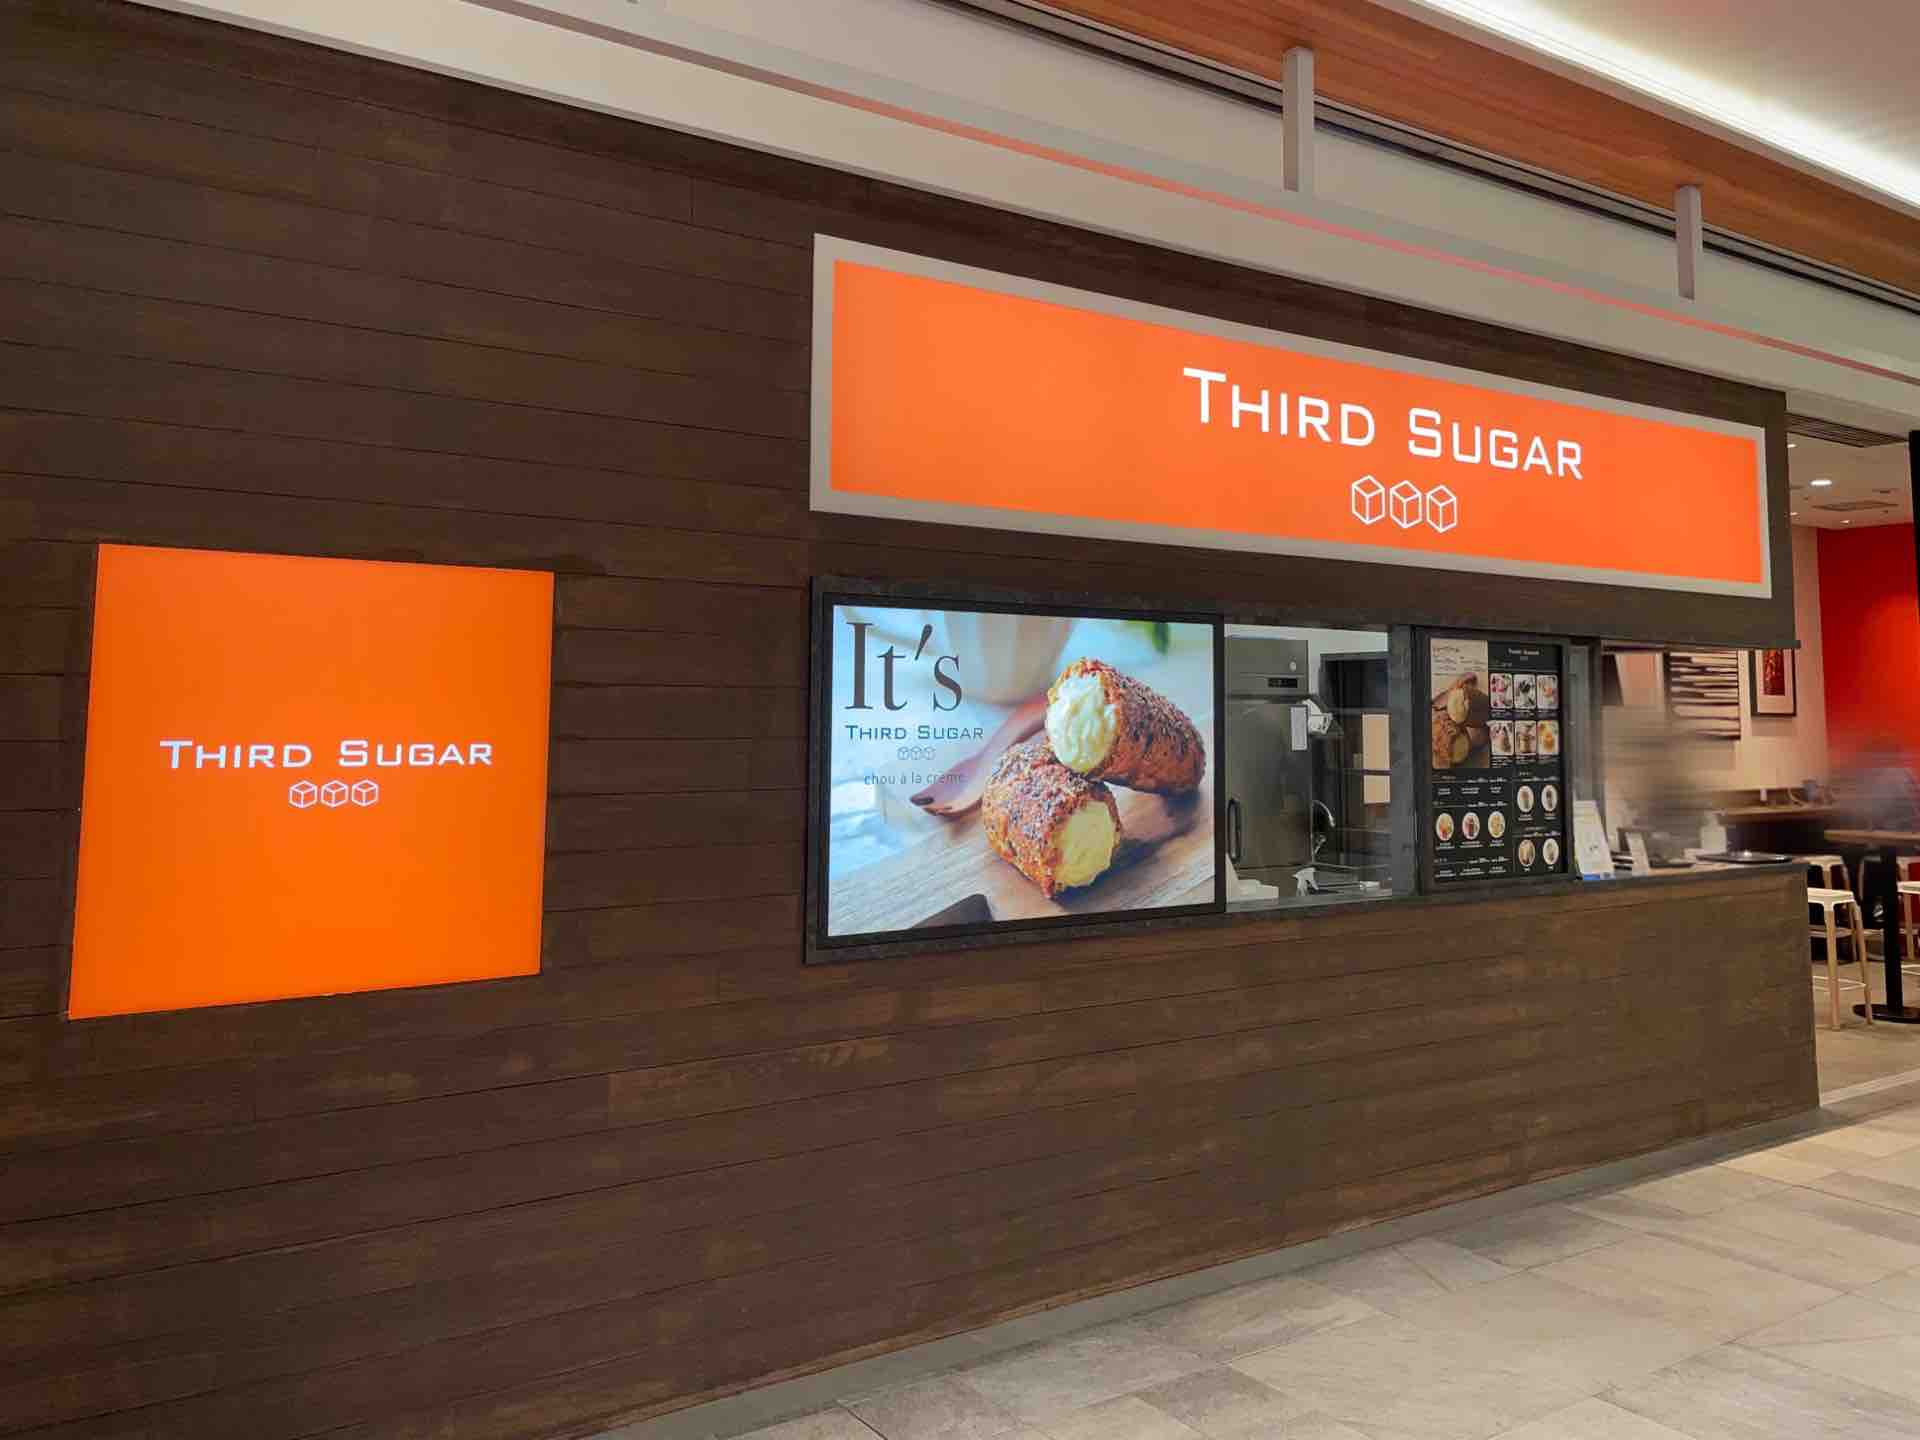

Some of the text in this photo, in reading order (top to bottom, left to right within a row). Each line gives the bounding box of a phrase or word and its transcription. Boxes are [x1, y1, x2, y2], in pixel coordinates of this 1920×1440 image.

[1183, 367, 1583, 480] THIRD SUGAR
[844, 622, 962, 712] It's
[844, 725, 984, 740] THIRD SUGAR
[159, 739, 493, 769] THIRD SUGAR
[864, 773, 896, 785] chou
[911, 771, 922, 784] la
